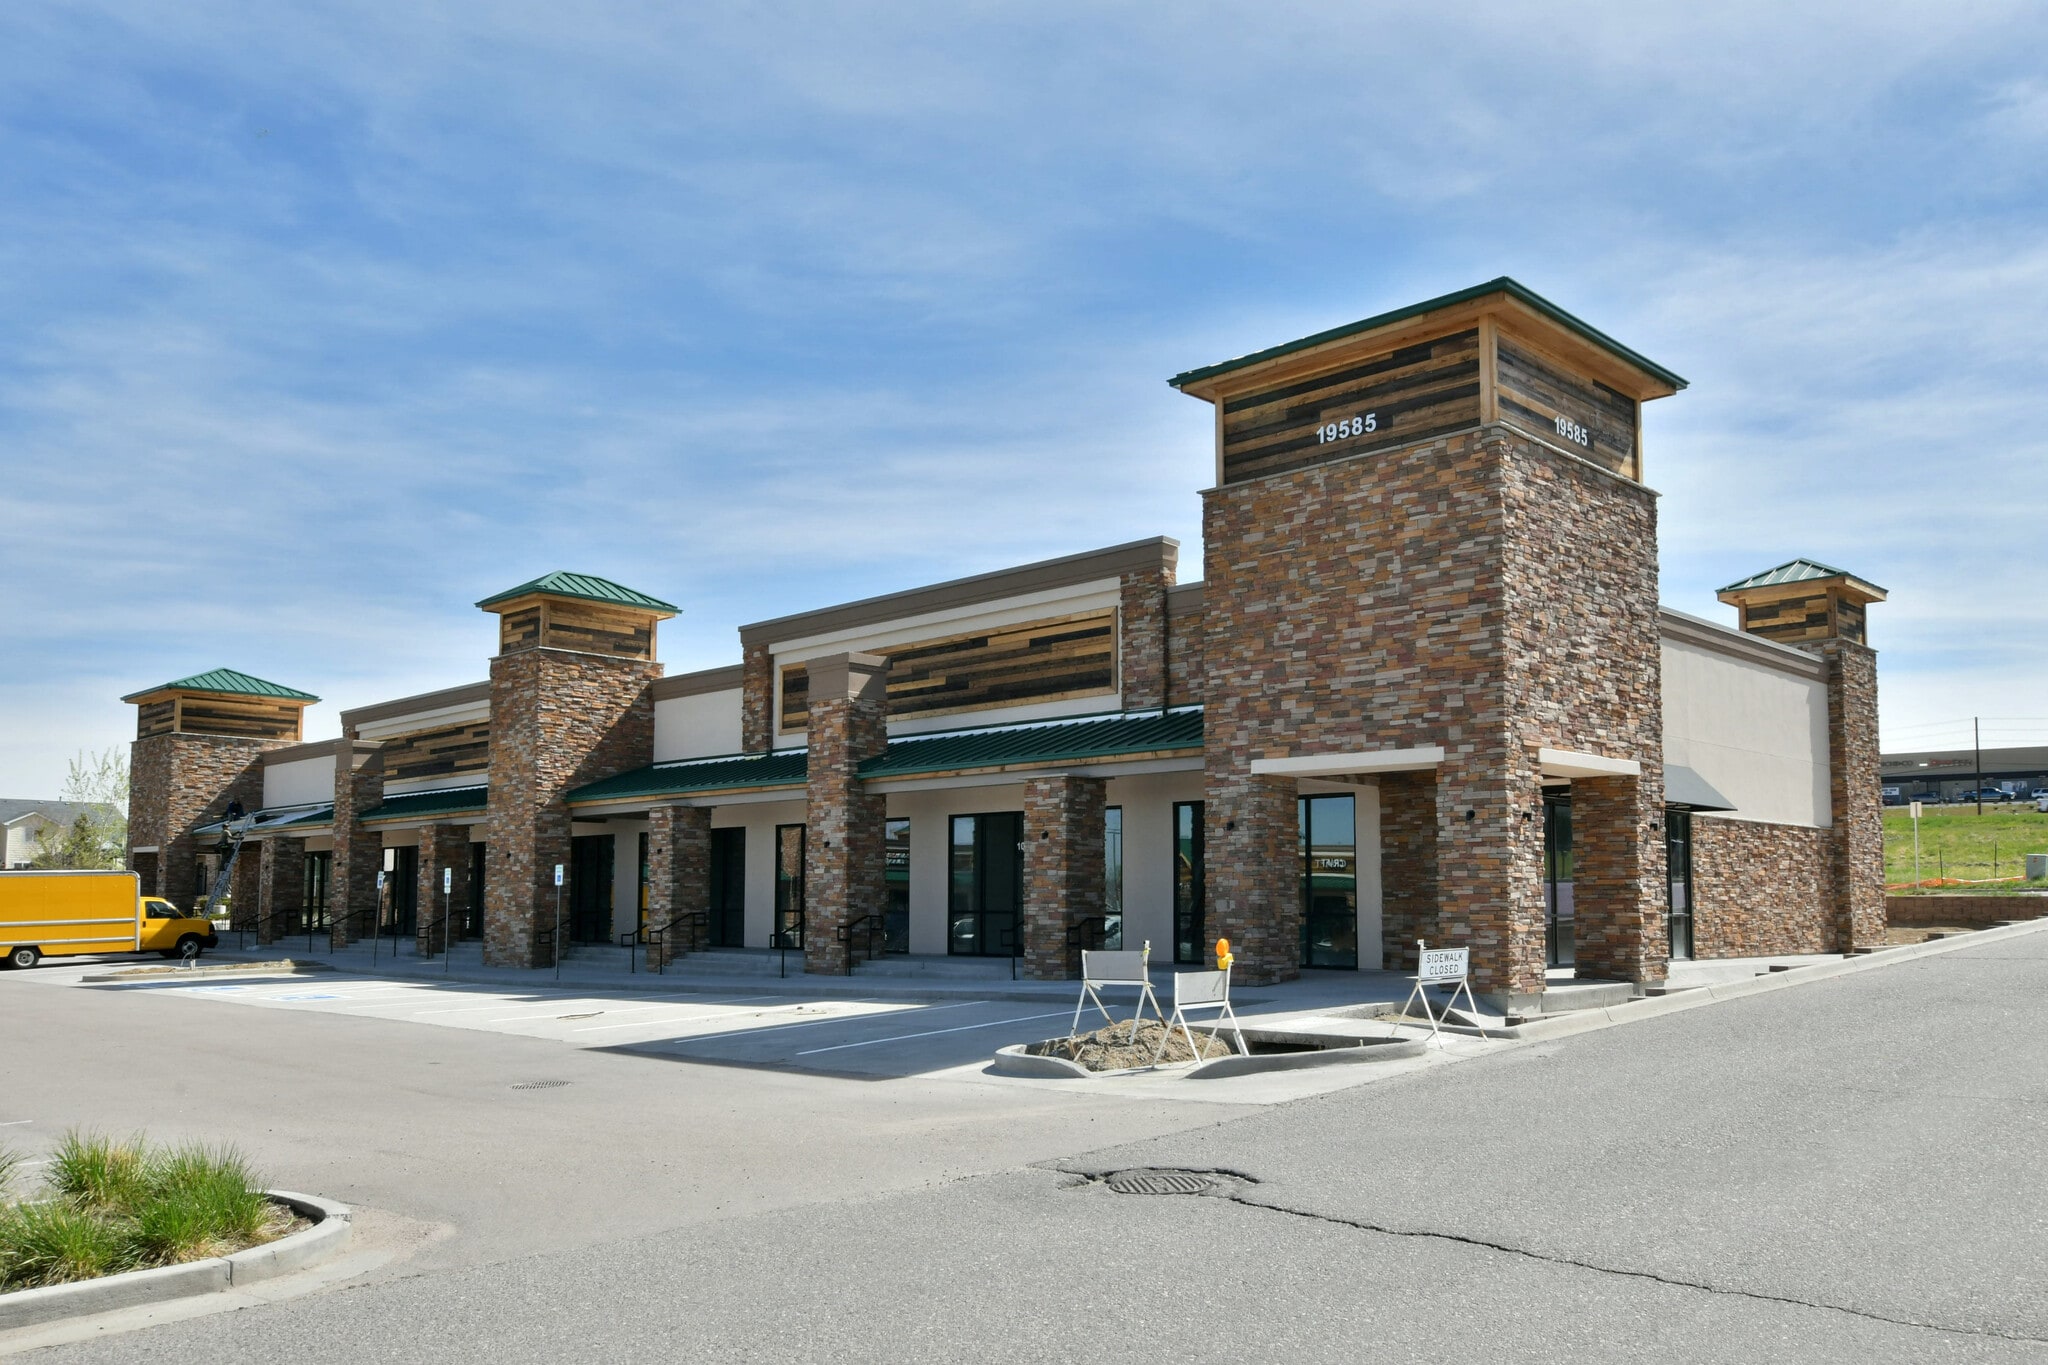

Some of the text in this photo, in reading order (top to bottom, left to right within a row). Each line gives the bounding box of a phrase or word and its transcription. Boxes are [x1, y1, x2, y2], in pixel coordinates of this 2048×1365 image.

[1316, 413, 1377, 444] 19585
[1554, 416, 1588, 446] 19585
[1426, 952, 1463, 963] SIDEWALK
[1429, 964, 1459, 975] CLOSED
